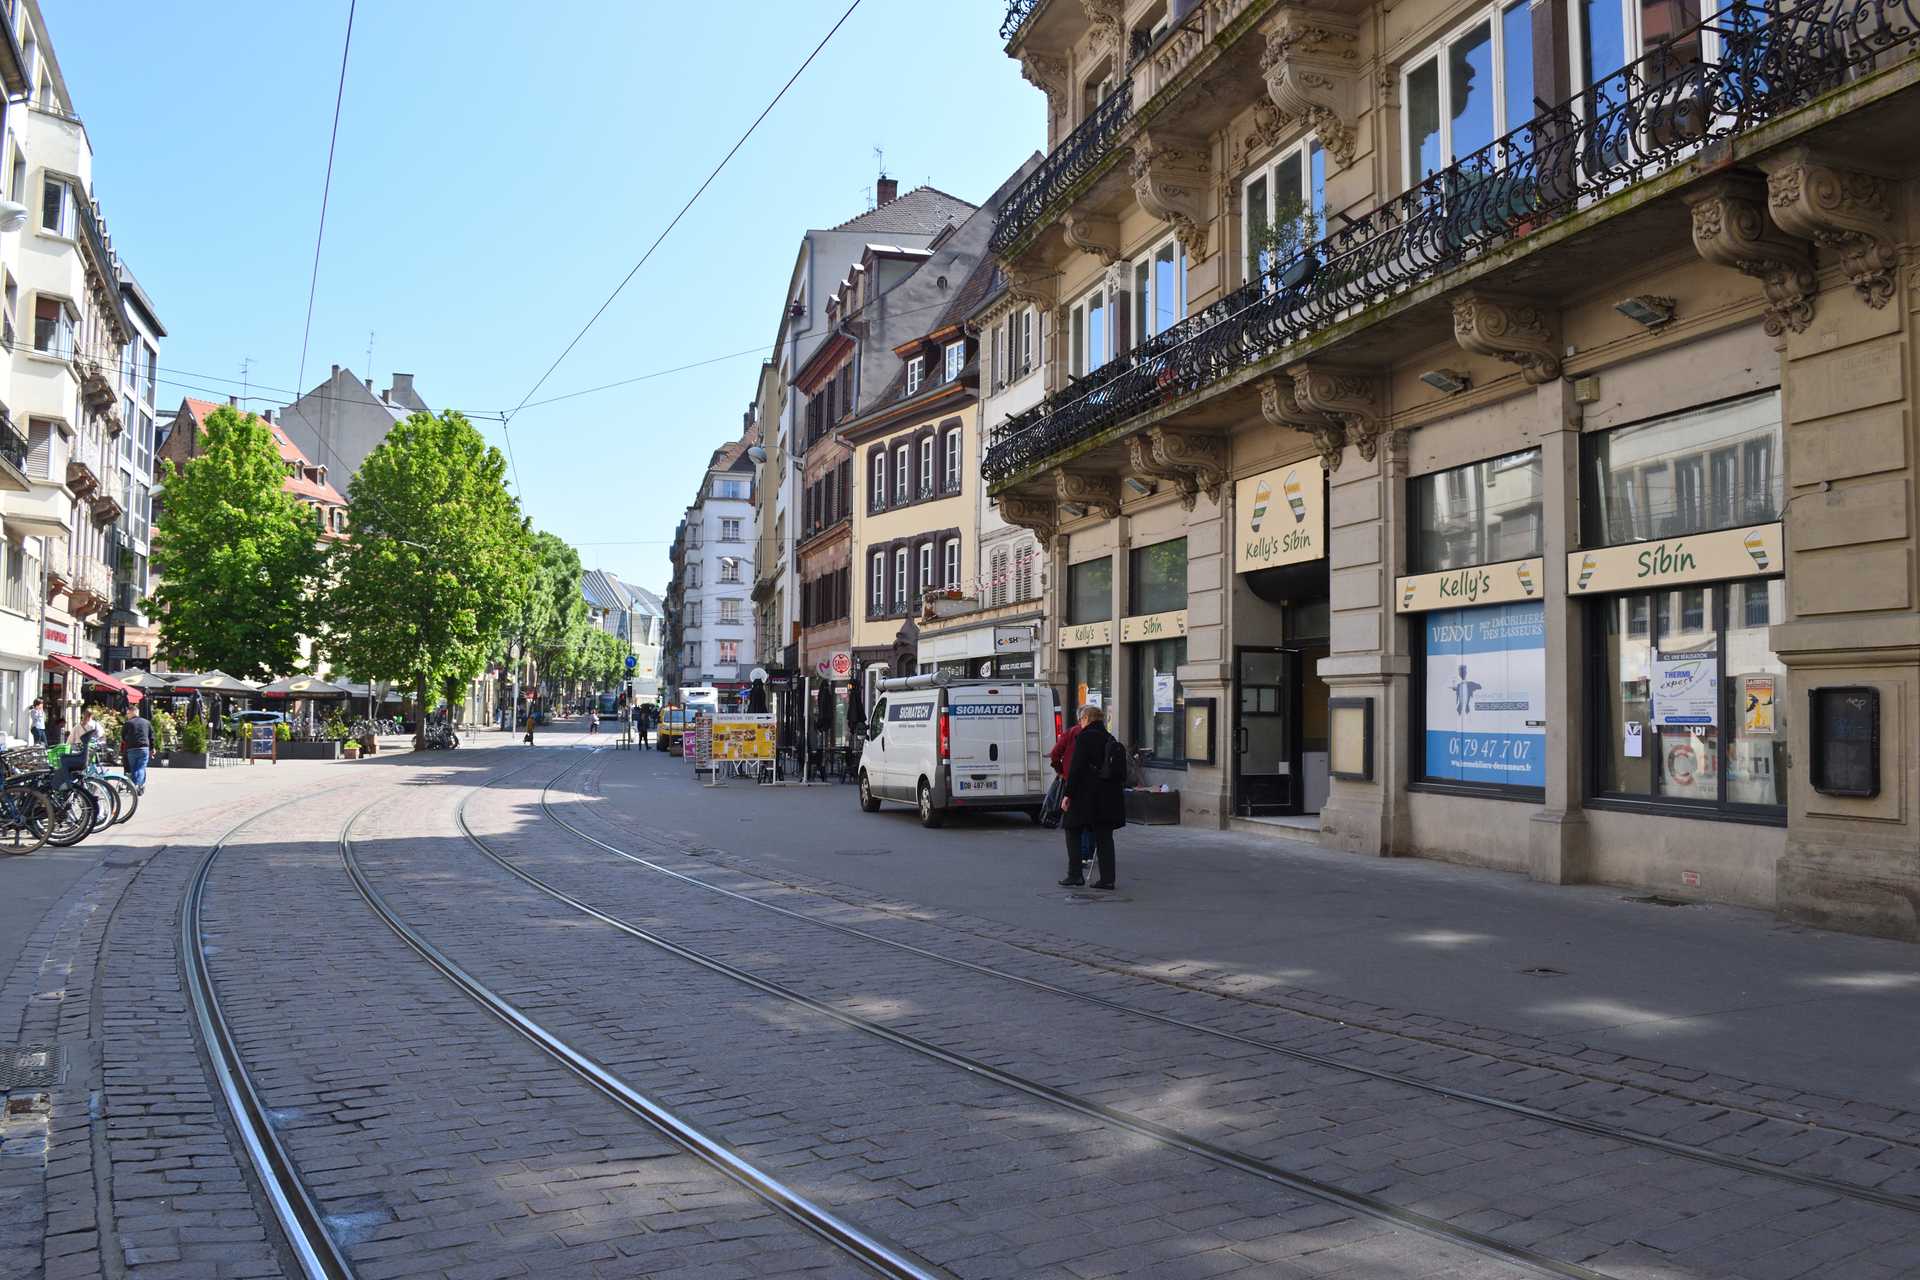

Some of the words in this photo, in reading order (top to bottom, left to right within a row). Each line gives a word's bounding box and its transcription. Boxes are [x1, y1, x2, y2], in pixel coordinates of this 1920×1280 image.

[1246, 536, 1278, 561] Kelly's
[1282, 529, 1311, 553] Síbín
[1638, 543, 1696, 578] Síbín
[1440, 569, 1490, 602] Kelly's
[1075, 625, 1095, 644] Kelly's
[1432, 624, 1474, 642] VENDU
[899, 705, 930, 719] SIGMATECH
[956, 705, 1020, 715] SIGMATECH
[1463, 739, 1479, 757] 79
[1480, 740, 1497, 758] 47
[1499, 740, 1511, 759] 7
[1513, 740, 1531, 759] 07
